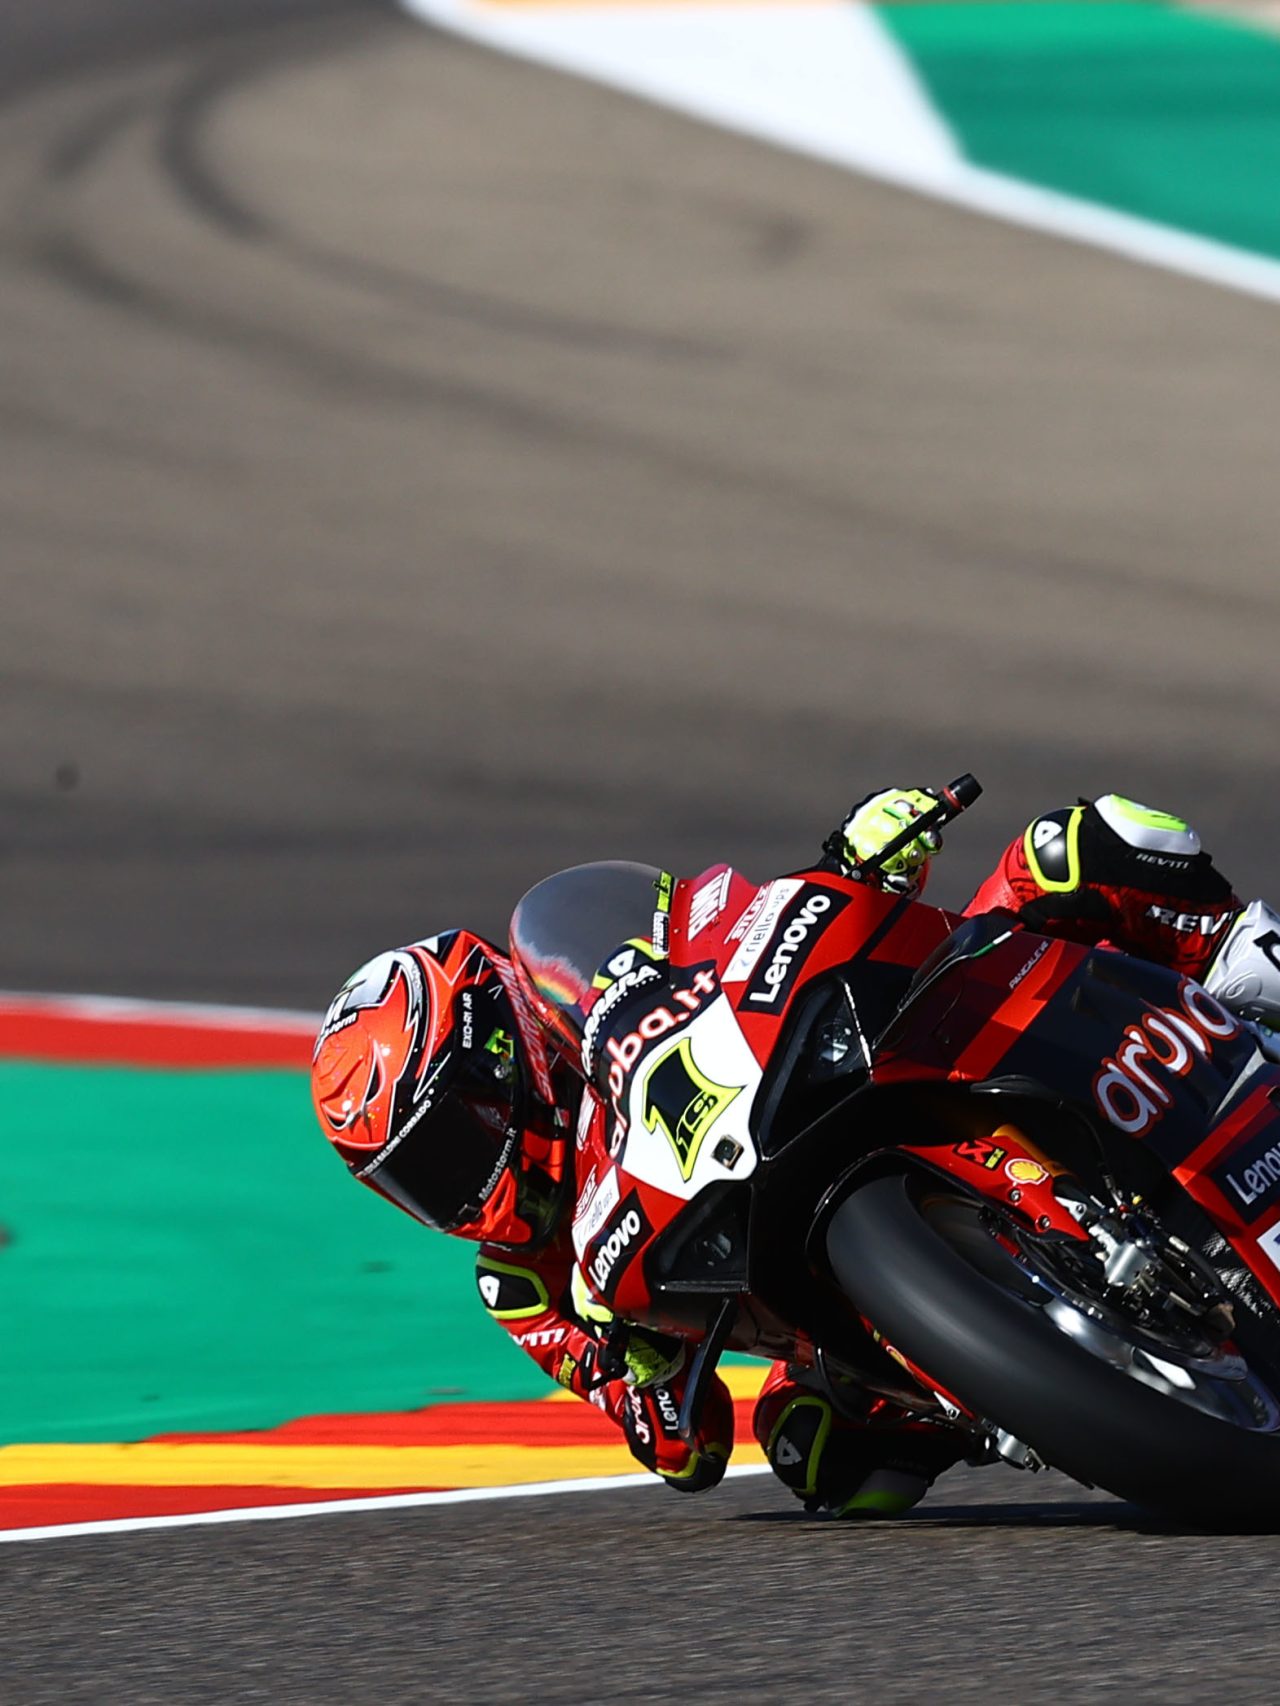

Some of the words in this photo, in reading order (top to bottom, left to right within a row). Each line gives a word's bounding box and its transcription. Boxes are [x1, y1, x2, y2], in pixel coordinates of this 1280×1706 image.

[746, 912, 776, 953] riello
[749, 894, 831, 1003] Lenovo
[608, 968, 716, 1159] aruba.it
[399, 1099, 432, 1138] CORRADO
[478, 1127, 517, 1201] Motostorm.it
[588, 1210, 641, 1292] Lenovo
